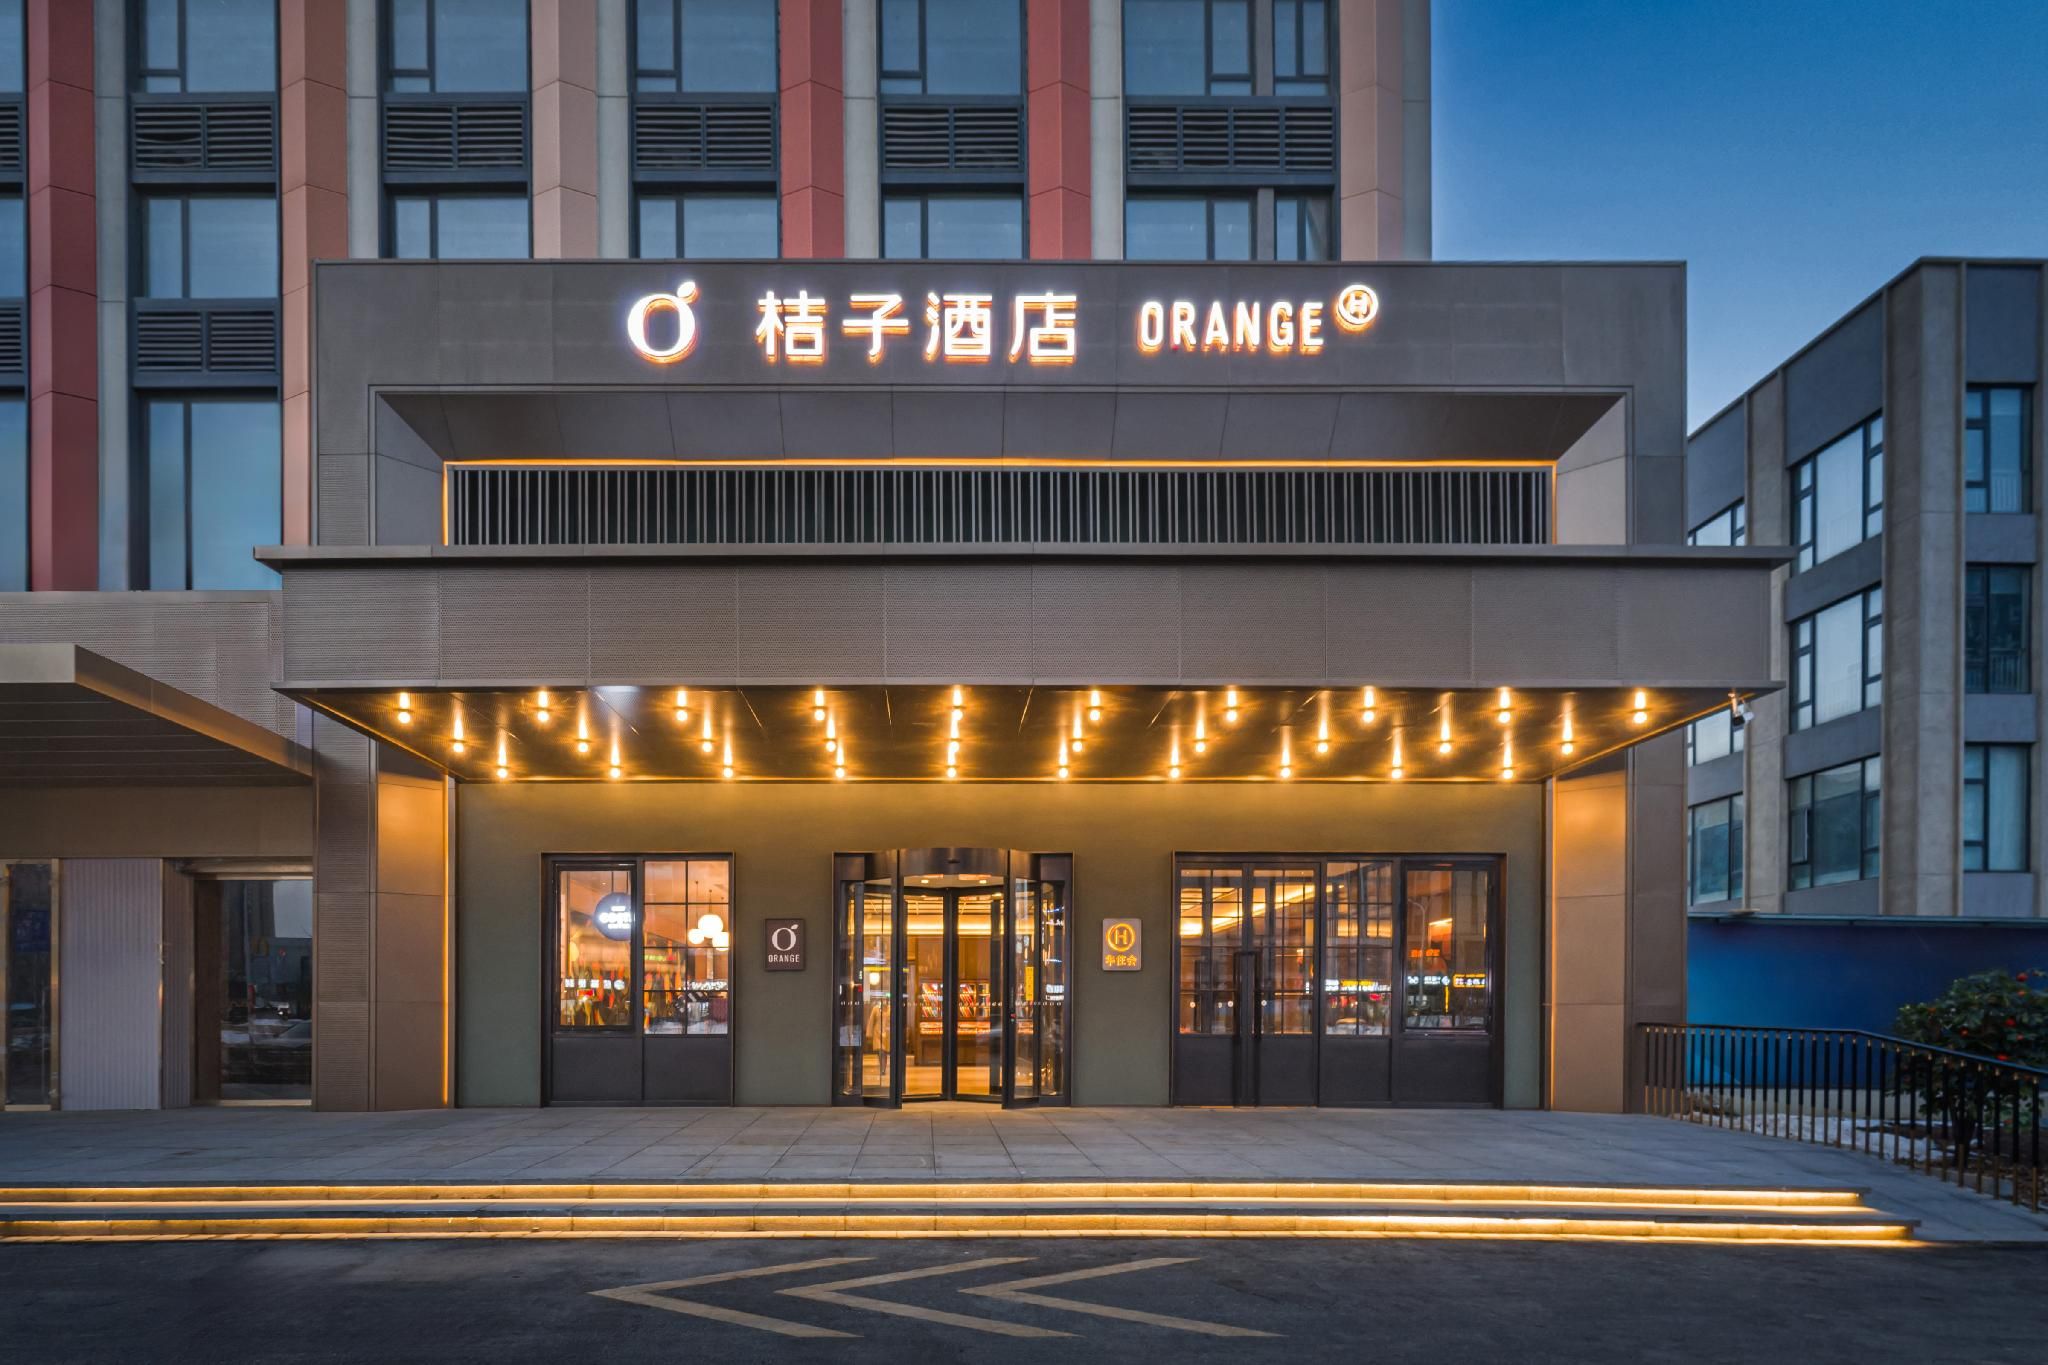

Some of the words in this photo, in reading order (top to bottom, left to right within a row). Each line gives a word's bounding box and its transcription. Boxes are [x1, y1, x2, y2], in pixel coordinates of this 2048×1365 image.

[756, 290, 1077, 361] 桔子酒店
[1139, 300, 1324, 350] ORANGE
[768, 954, 800, 963] ORANGE
